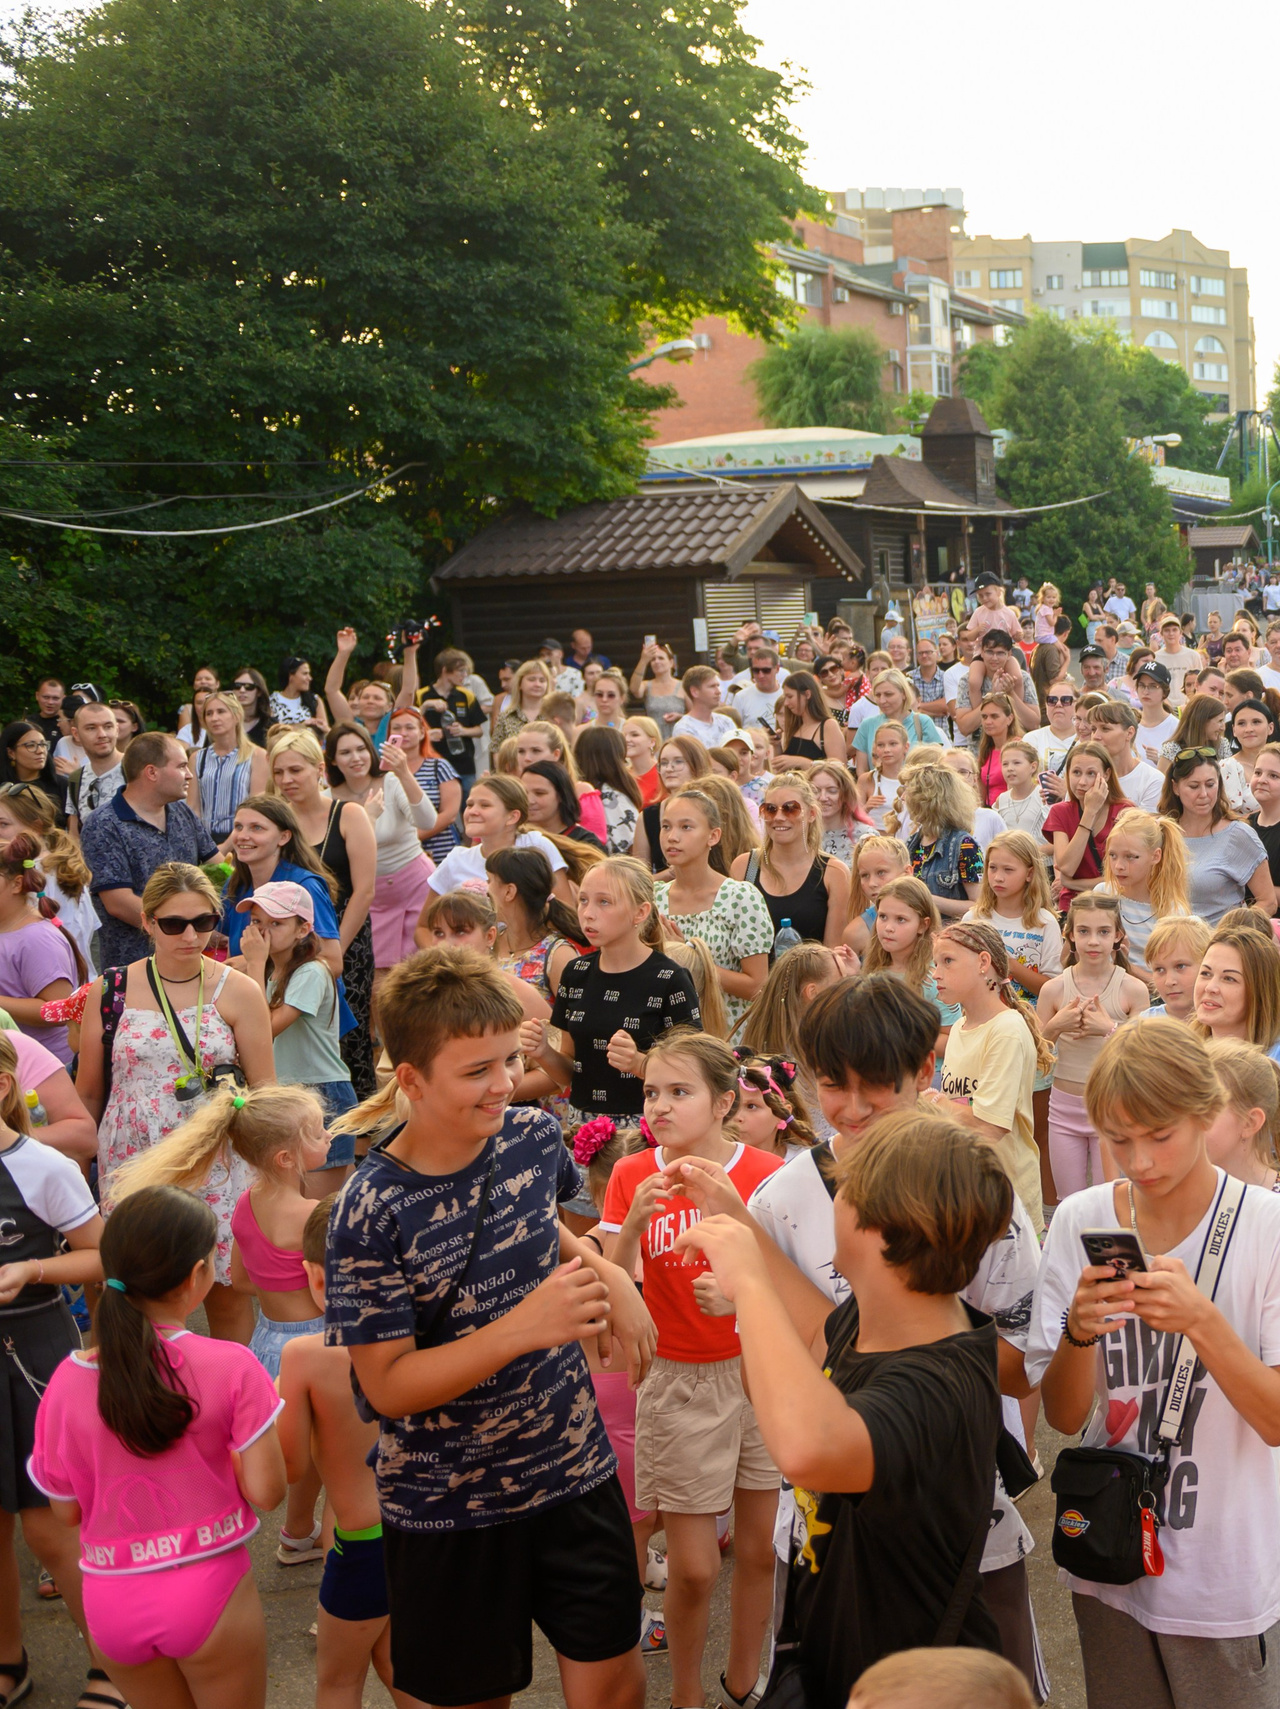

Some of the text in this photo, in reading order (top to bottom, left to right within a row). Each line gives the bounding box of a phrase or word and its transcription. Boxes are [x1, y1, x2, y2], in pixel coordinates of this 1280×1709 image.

[647, 1212, 675, 1260] LOS
[197, 1507, 245, 1547] BABY
[1143, 1530, 1152, 1554] NIKE
[129, 1533, 182, 1562] BABY
